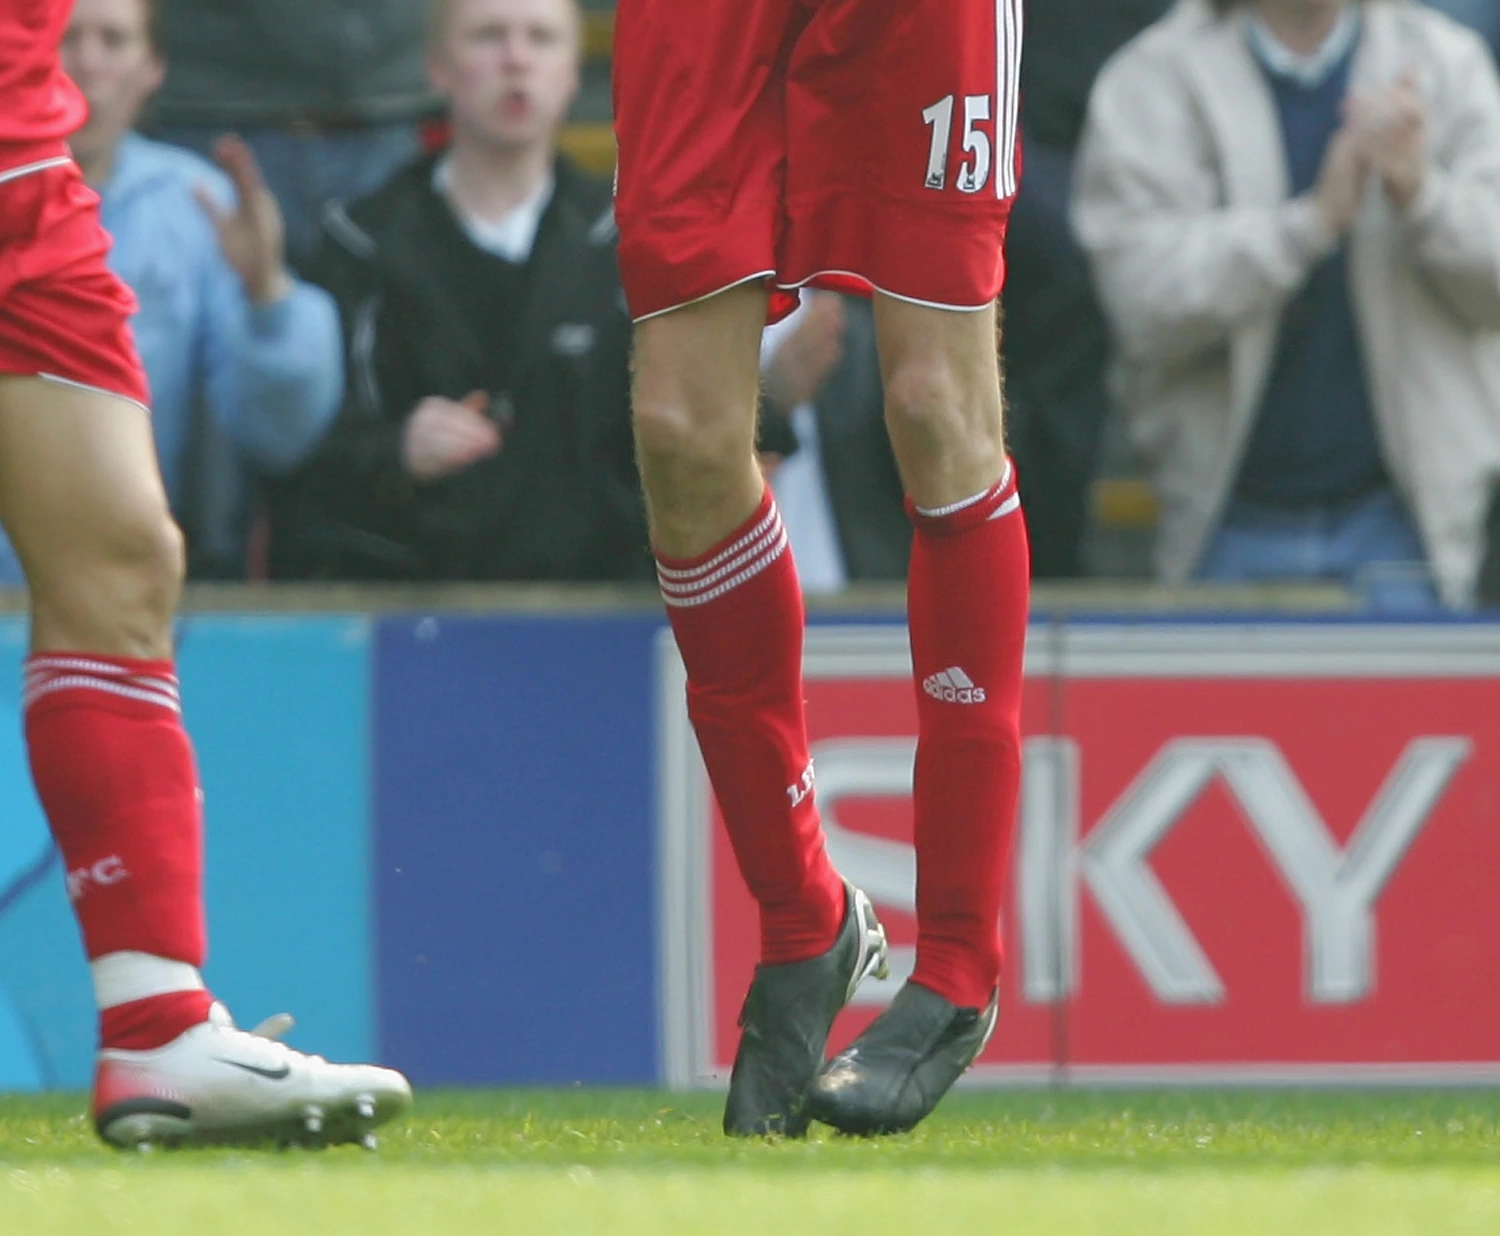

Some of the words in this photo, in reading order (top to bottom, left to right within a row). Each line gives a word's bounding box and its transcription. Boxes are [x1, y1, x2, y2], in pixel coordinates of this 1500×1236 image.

[921, 94, 991, 193] 15
[923, 678, 986, 703] adidas
[786, 757, 815, 808] LF
[803, 735, 1472, 1003] SKY
